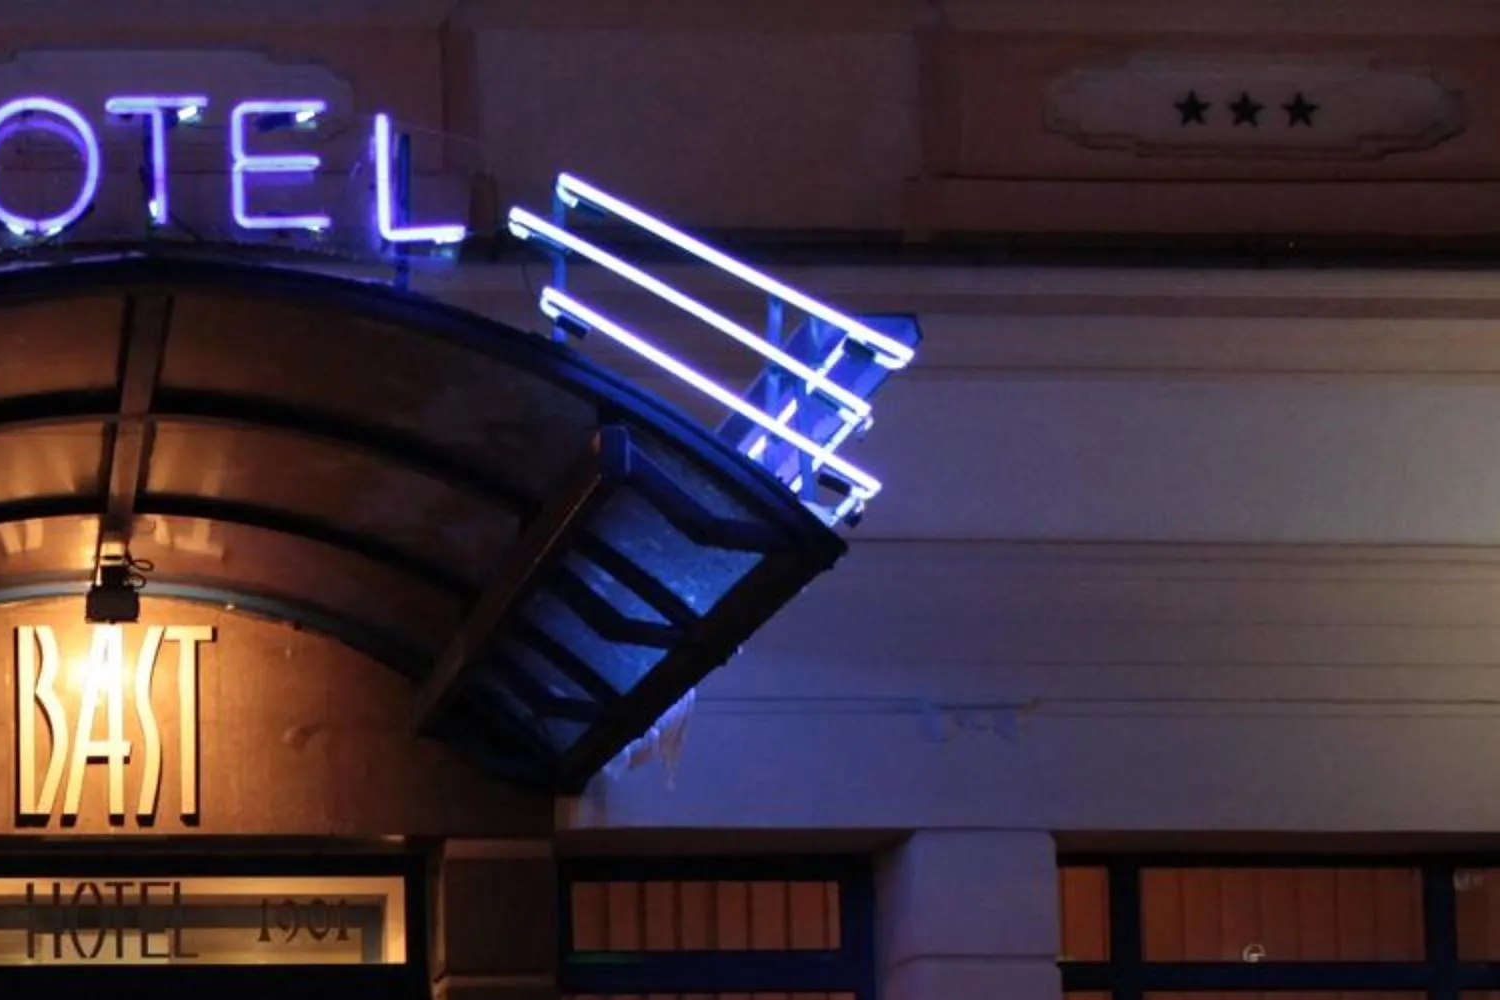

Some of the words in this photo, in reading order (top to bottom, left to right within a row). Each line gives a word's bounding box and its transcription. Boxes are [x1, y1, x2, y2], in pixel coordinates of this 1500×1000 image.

[14, 621, 216, 827] BAST
[26, 882, 199, 959] HOTEL
[258, 898, 349, 942] 1901
